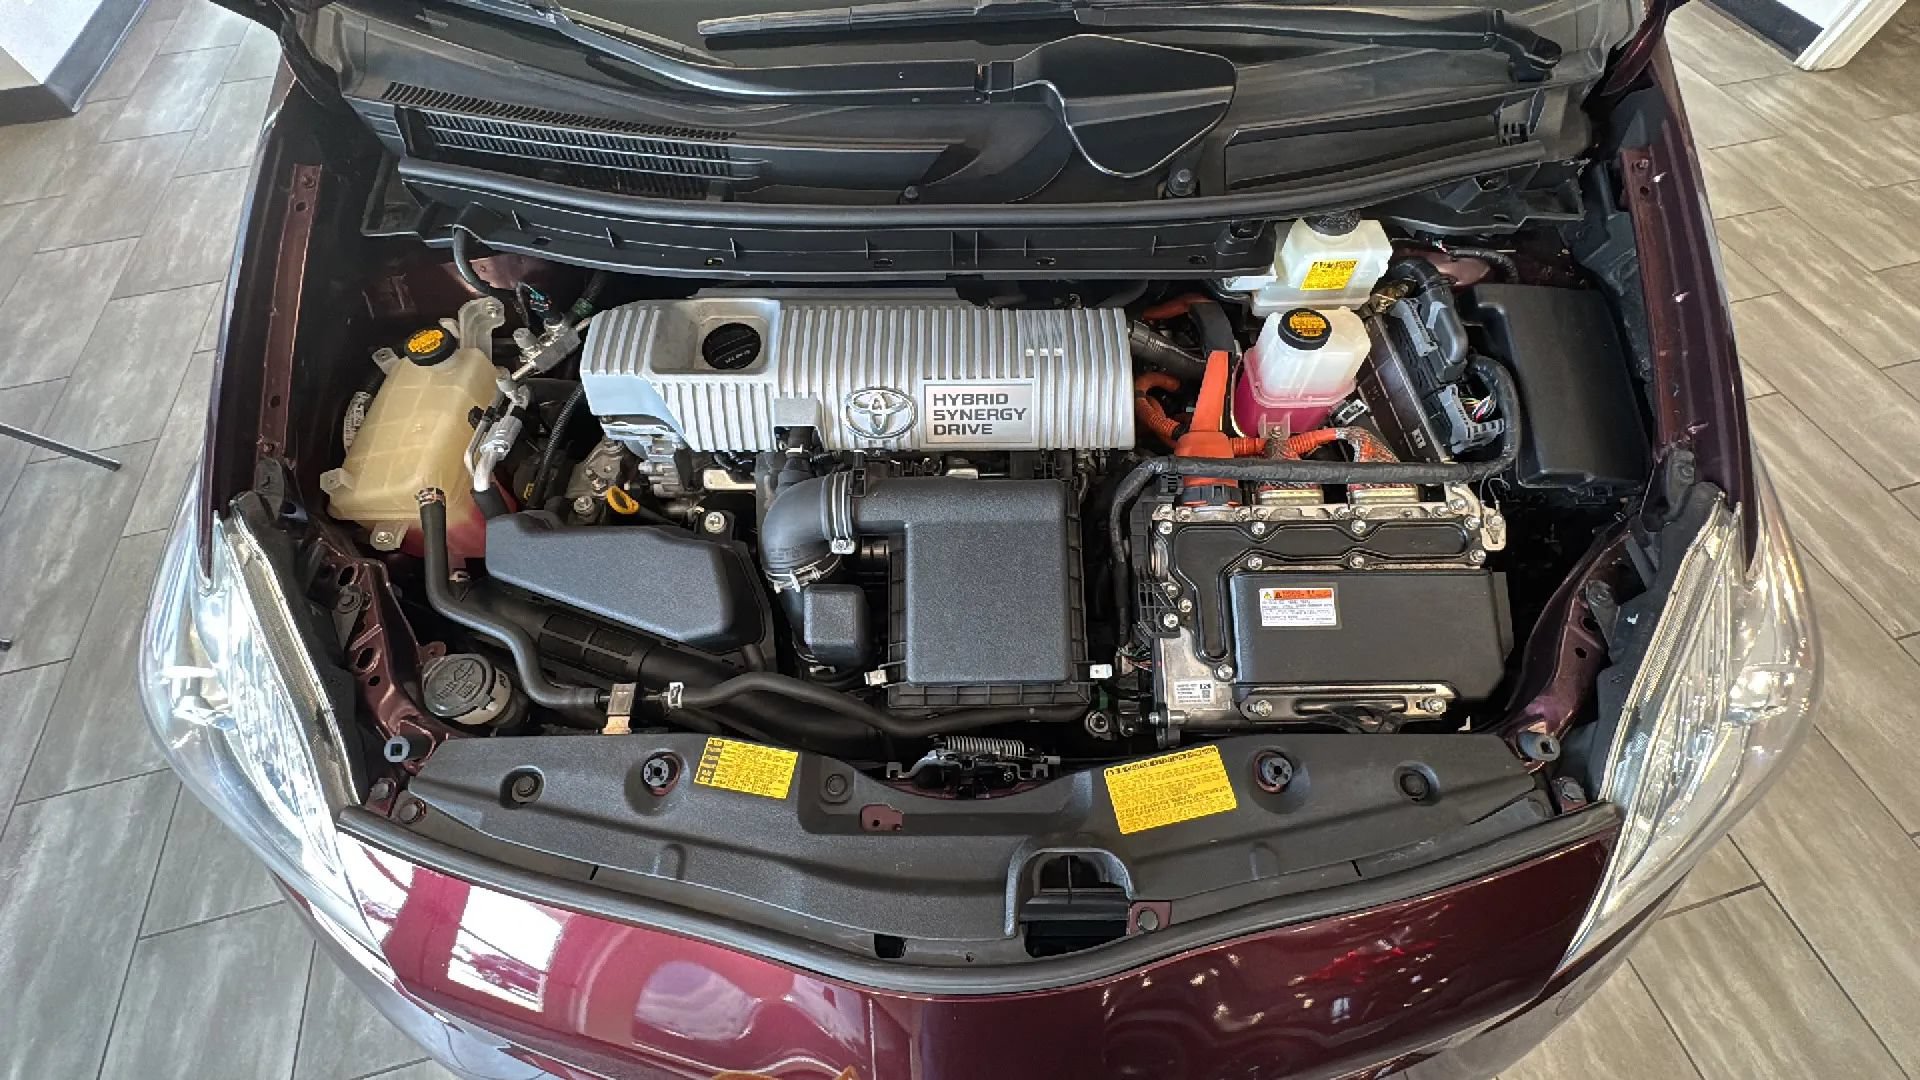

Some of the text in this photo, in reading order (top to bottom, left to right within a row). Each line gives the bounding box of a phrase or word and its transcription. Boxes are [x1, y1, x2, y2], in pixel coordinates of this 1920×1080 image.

[933, 393, 1009, 406] HYBRID
[933, 408, 1027, 421] SYNERGY
[933, 423, 993, 436] DRIVE
